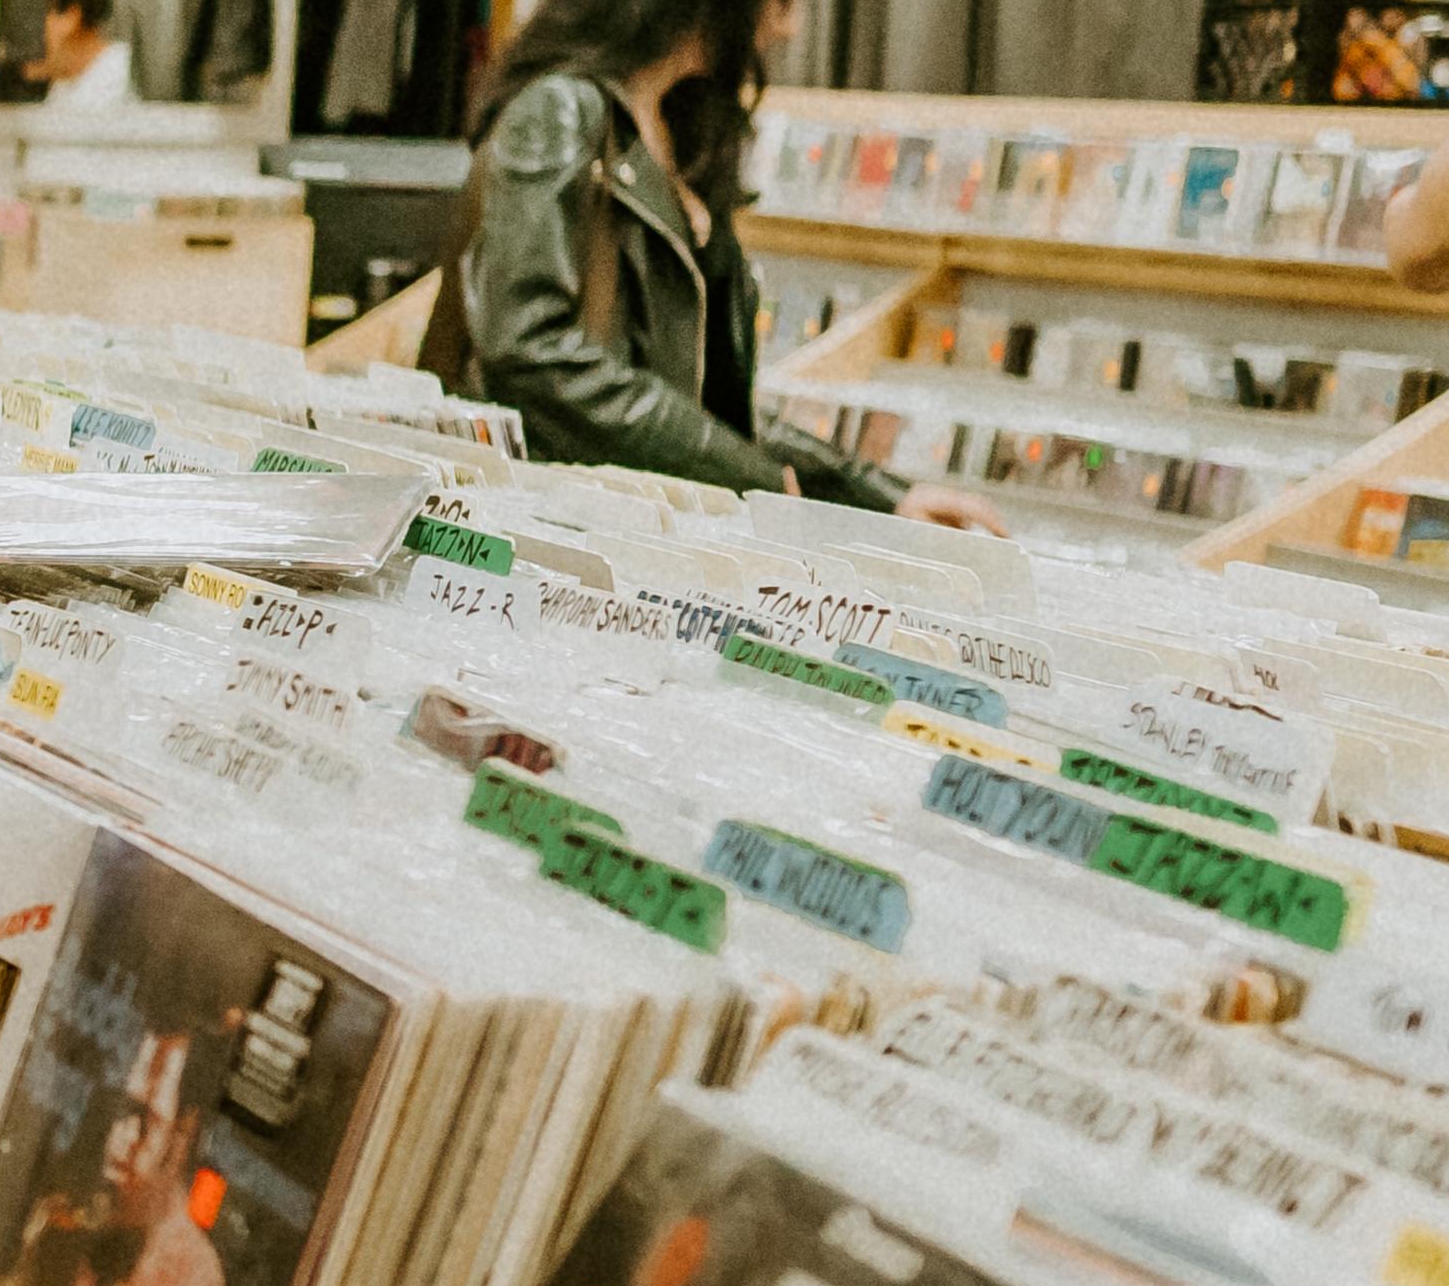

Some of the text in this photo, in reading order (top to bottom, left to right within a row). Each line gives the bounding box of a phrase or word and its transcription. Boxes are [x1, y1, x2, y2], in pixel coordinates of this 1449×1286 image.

[418, 519, 461, 558] JAZZ
[190, 571, 227, 607] SONNY
[815, 594, 892, 649] SCOTT
[1008, 642, 1053, 690] DISCO
[11, 673, 40, 704] SUN
[284, 672, 351, 730] SMITH
